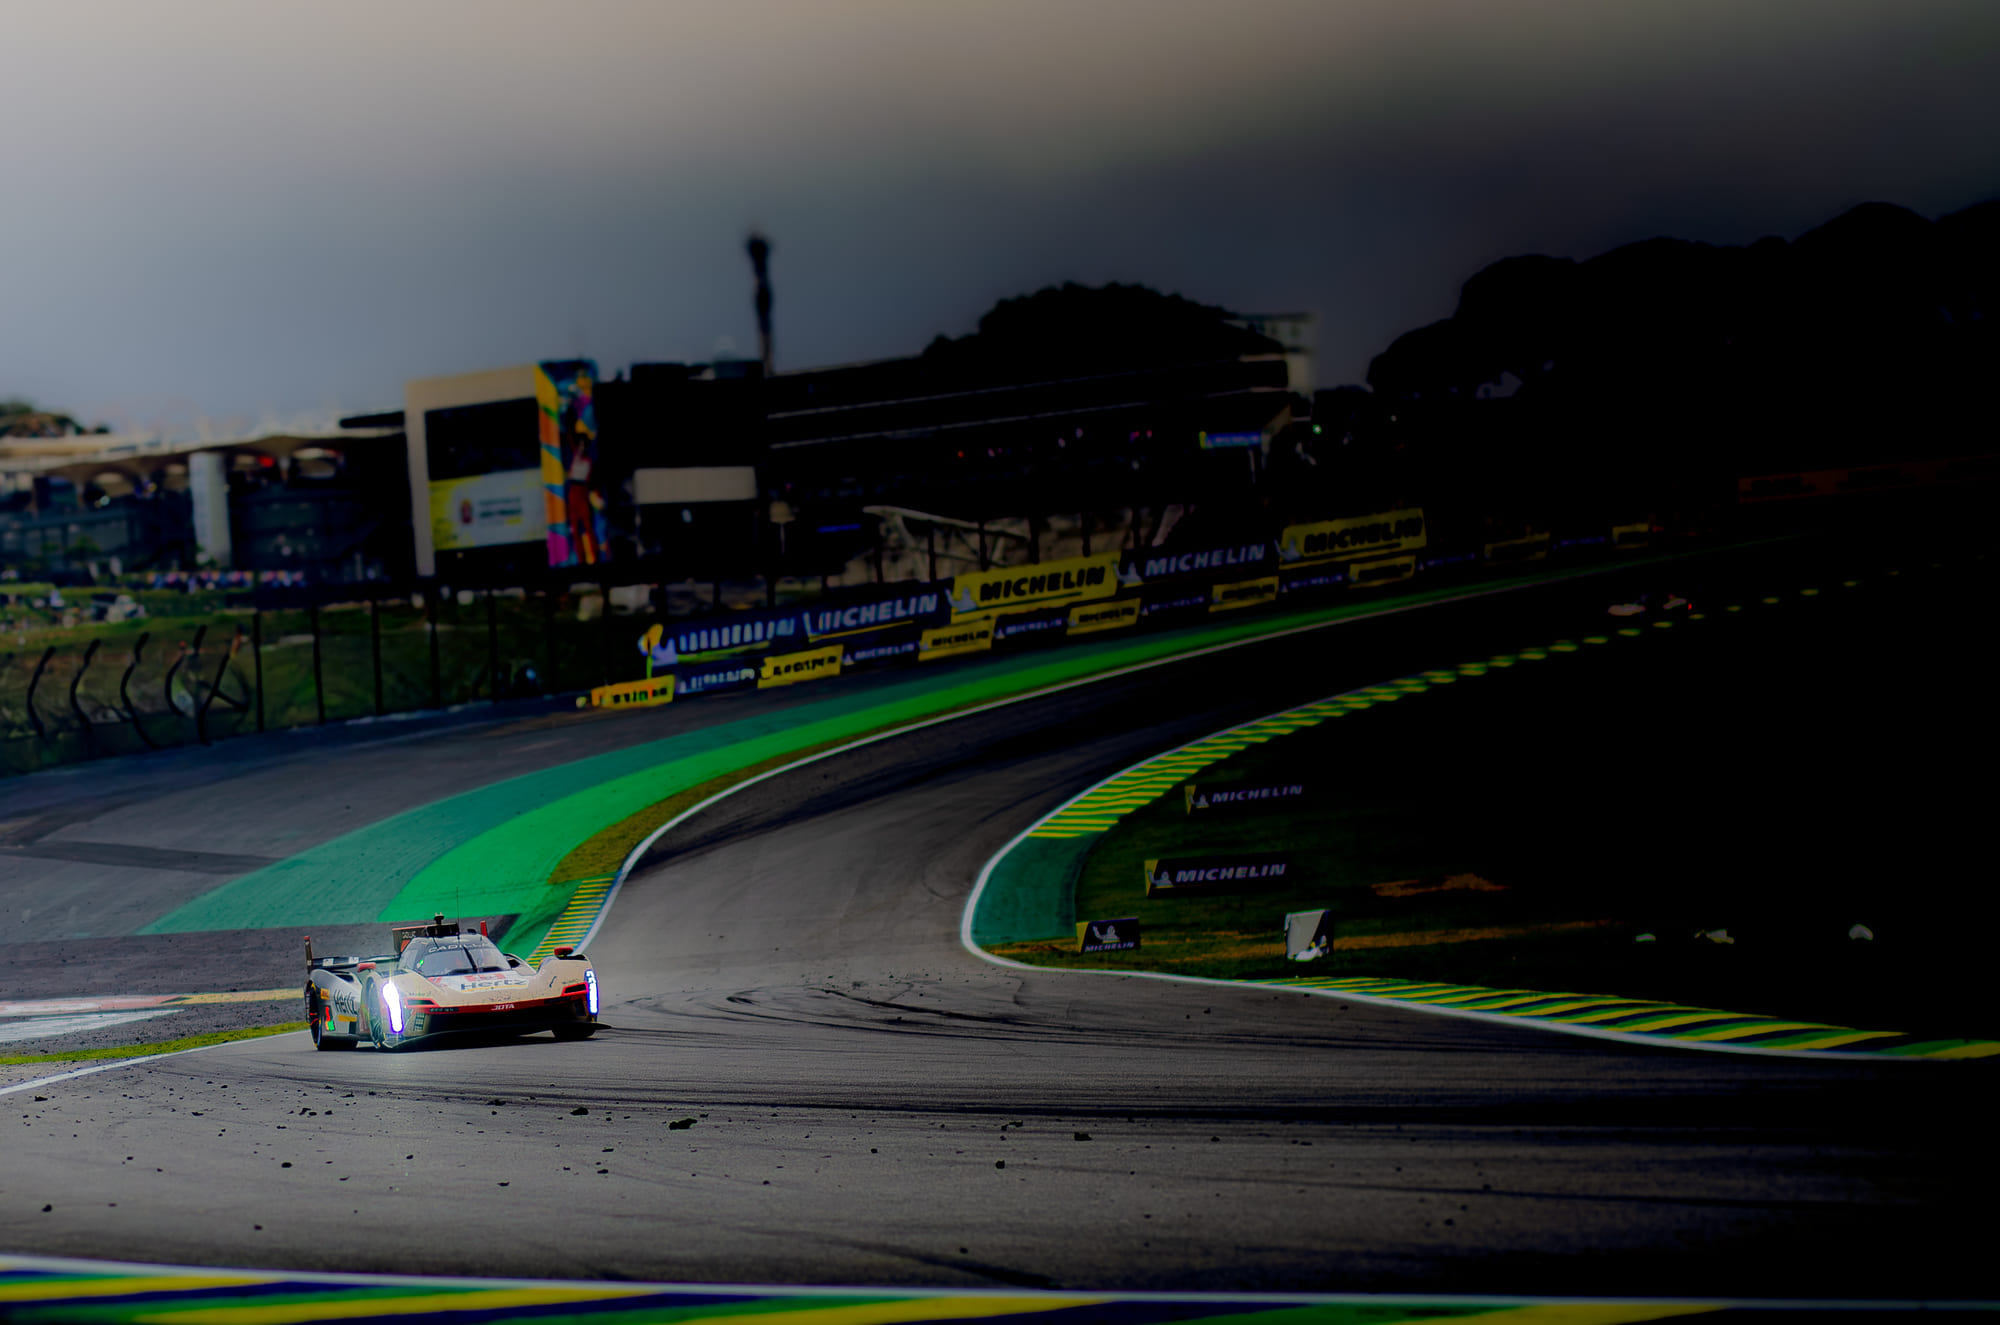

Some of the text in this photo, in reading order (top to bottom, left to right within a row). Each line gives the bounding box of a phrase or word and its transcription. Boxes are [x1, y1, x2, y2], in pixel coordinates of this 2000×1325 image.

[1145, 544, 1266, 577] MICHELIN
[980, 566, 1105, 601] MICHELIN
[818, 593, 939, 634] MICHELIN
[1211, 784, 1303, 803] MICHELIN
[1175, 863, 1287, 883] MICHELIN
[1084, 941, 1136, 952] MICHELIN
[460, 978, 528, 991] Hertz
[491, 1003, 515, 1011] JOTA
